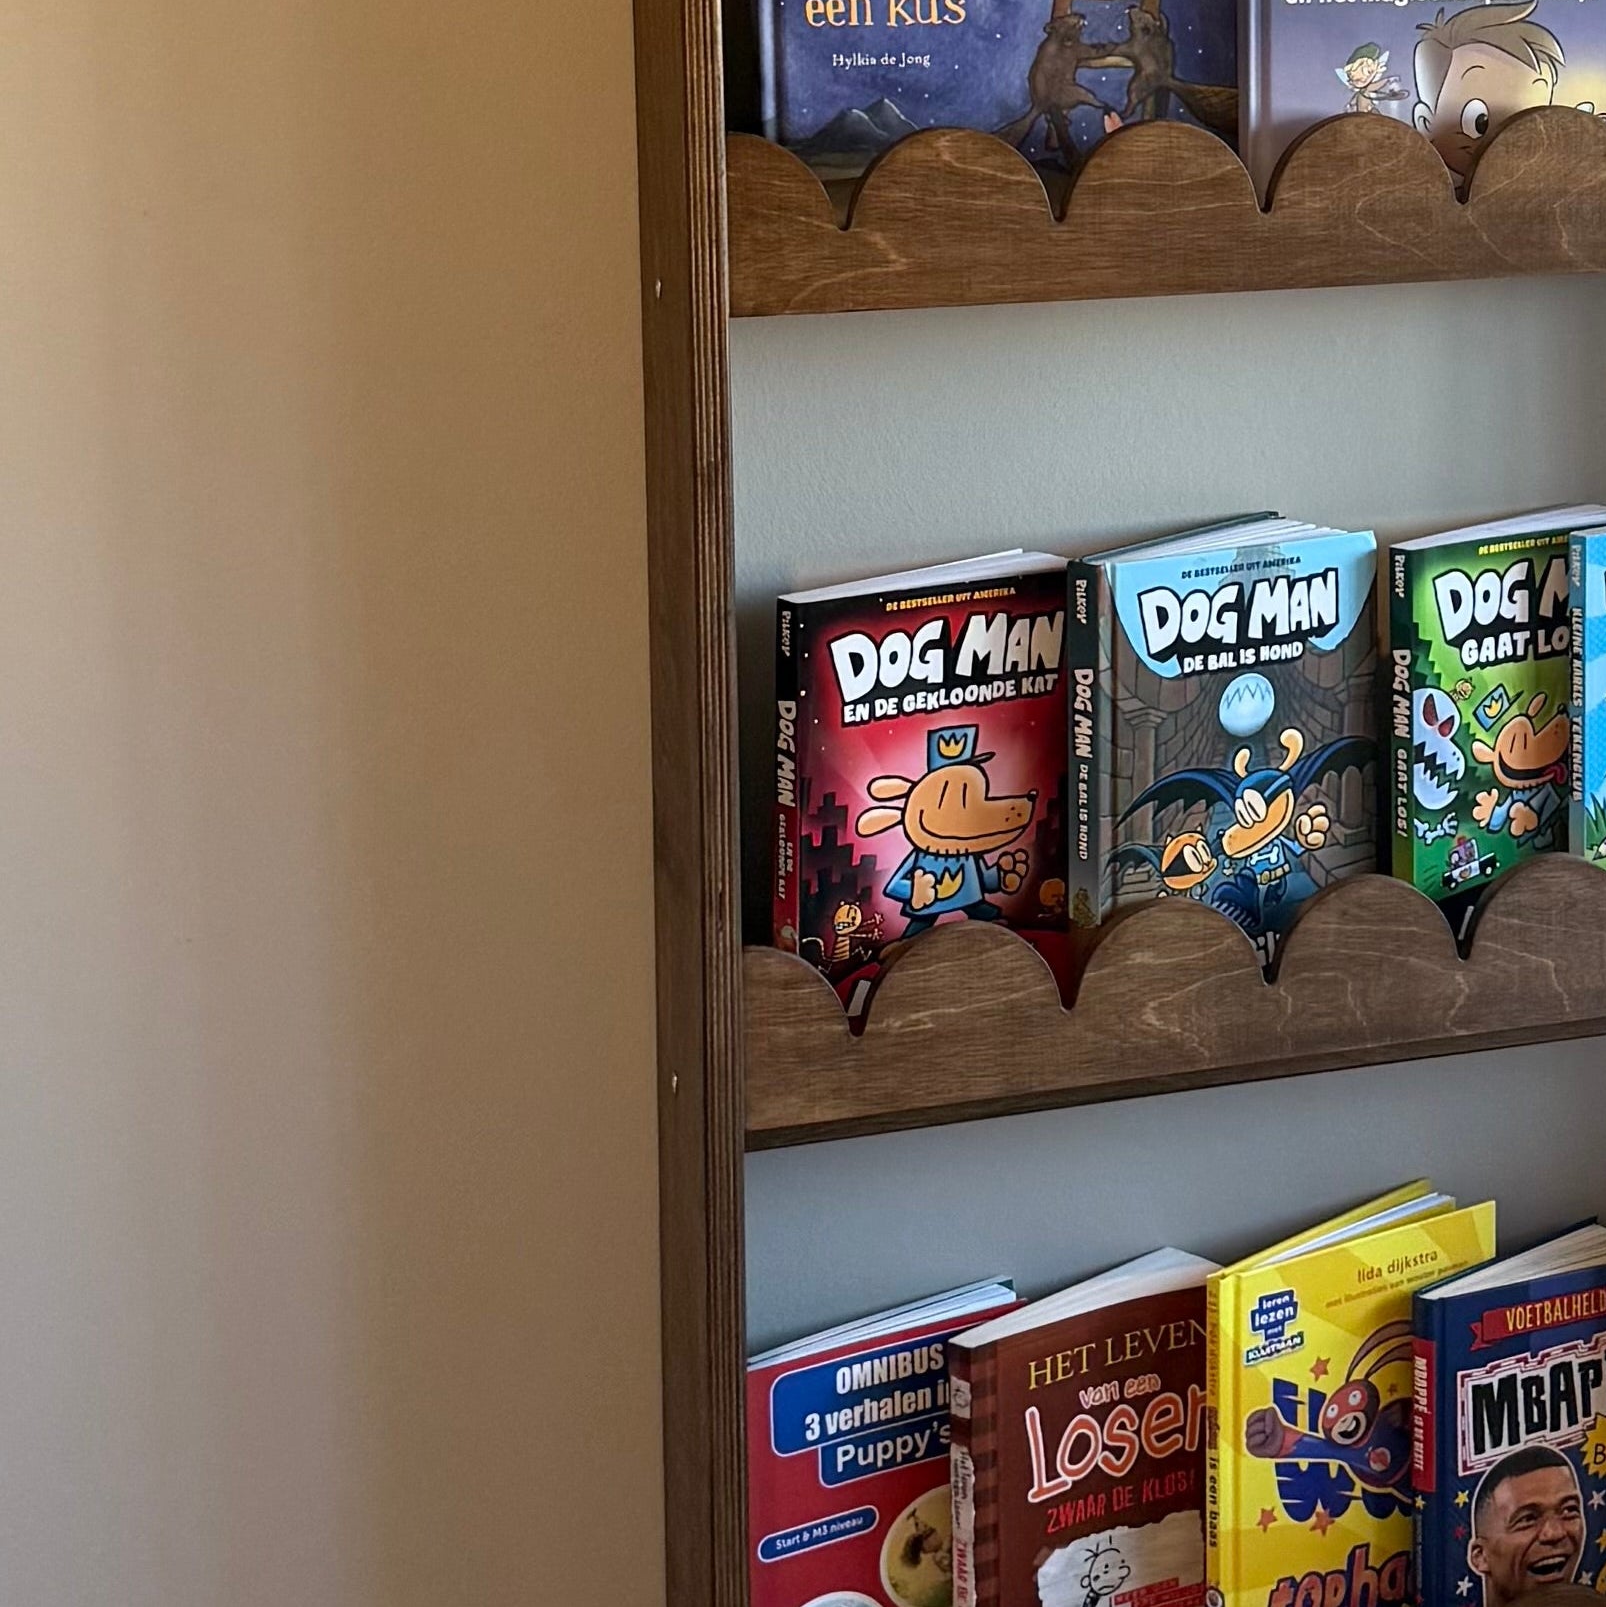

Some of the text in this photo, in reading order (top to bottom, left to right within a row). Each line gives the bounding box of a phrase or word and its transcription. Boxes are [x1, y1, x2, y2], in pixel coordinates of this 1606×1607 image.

[832, 52, 931, 70] Hylkia de Jong
[1181, 556, 1302, 579] DE BESTSELLER UIT AMERIKA
[1478, 546, 1488, 555] DE
[1489, 539, 1536, 554] BESTSELLER
[885, 587, 1016, 612] DE BESTSELLER UIT AMERIKA
[1140, 570, 1337, 655] DOG MAN
[1434, 561, 1529, 641] DOG
[830, 611, 1065, 703] DOG MAN
[1183, 641, 1304, 674] DE BAL IS HOND
[1461, 625, 1571, 666] GAAT LO
[1392, 649, 1412, 694] DOG
[843, 674, 1058, 723] EN DE GEKLOONDE KAT
[1392, 693, 1411, 739] MAN
[1572, 607, 1583, 801] KLEINE KARELS TEKENCLUB
[777, 701, 796, 808] DOG MAN
[1073, 668, 1094, 860] DOG MAN DE BAL IS HOND
[1397, 748, 1408, 794] GAAT
[1387, 1250, 1438, 1274] dijkstra
[1255, 1306, 1294, 1327] lezen
[1262, 1295, 1290, 1310] leren
[836, 1343, 944, 1395] OMNIBUS
[1028, 1343, 1096, 1391] HET
[1104, 1319, 1207, 1366] LEVEN
[1079, 1373, 1161, 1409] van een
[805, 1413, 821, 1441] 3
[824, 1388, 932, 1435] verhalen
[837, 1421, 951, 1472] Puppy's
[1025, 1384, 1207, 1503] Loser
[1209, 1456, 1219, 1470] is
[1046, 1493, 1107, 1534] ZWAAR
[1112, 1485, 1134, 1512] DE
[1209, 1475, 1218, 1505] een
[776, 1517, 864, 1550] Start & M3 niveau
[1209, 1511, 1220, 1549] baas
